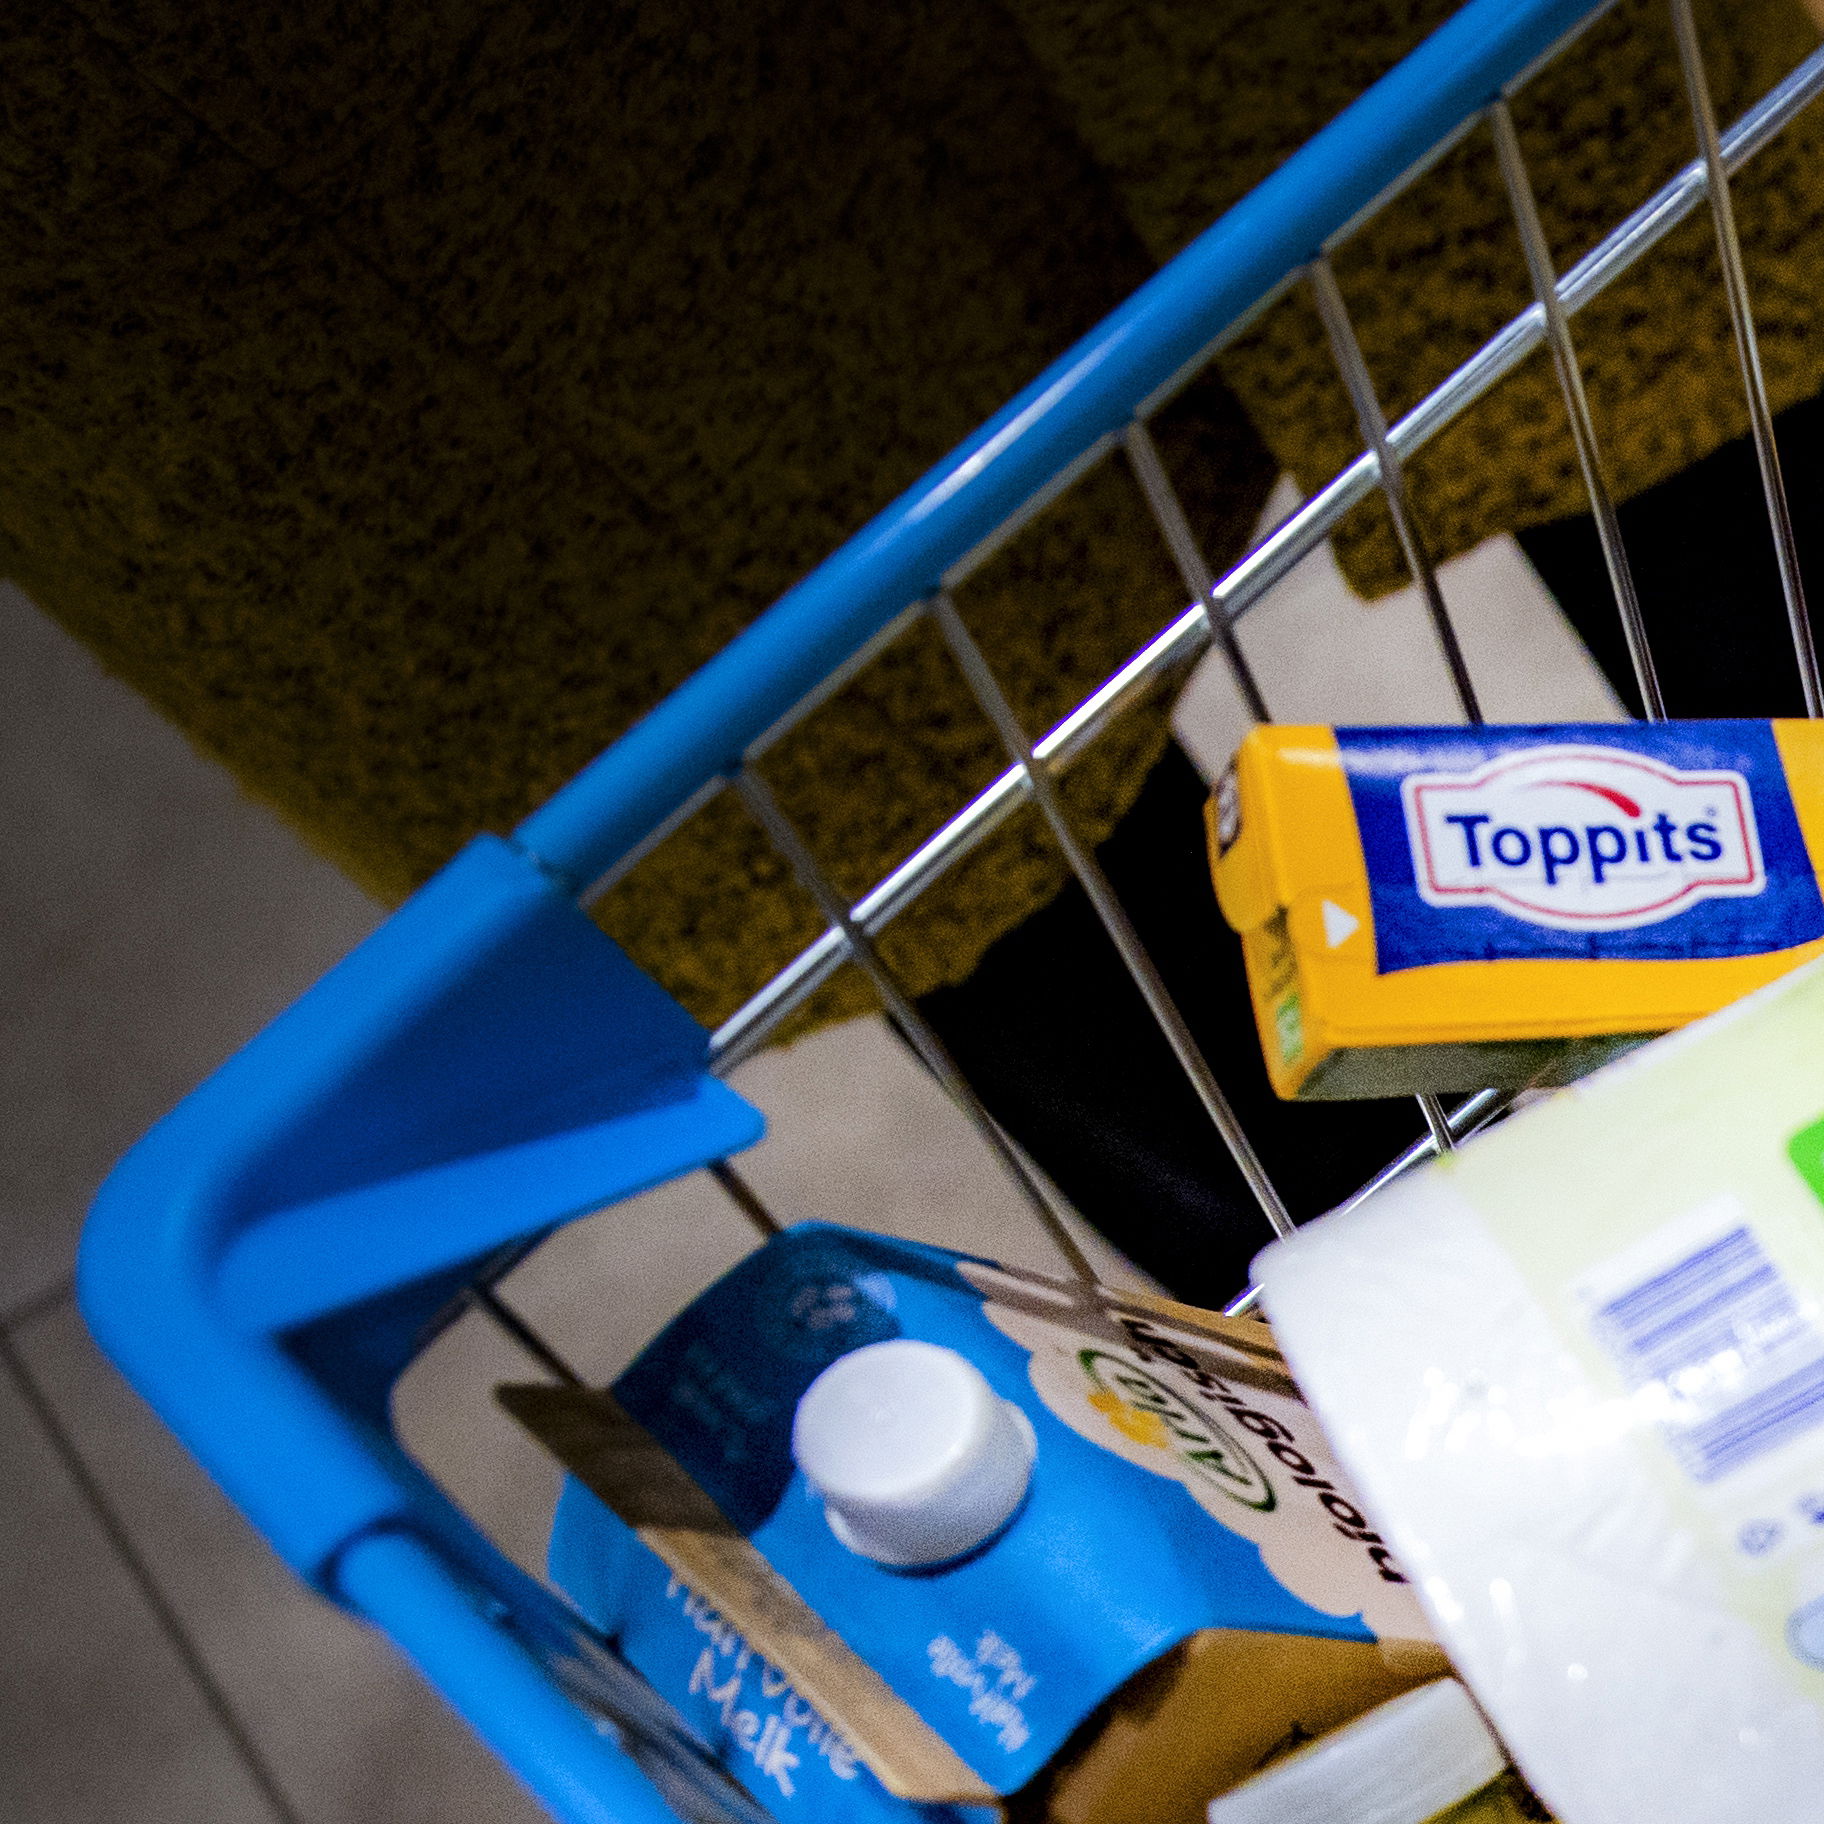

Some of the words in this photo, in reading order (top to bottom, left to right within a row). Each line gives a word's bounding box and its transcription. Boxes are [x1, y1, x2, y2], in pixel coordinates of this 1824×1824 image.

[1445, 804, 1724, 885] Toppits
[1118, 1372, 1255, 1488] Arla
[690, 1647, 799, 1800] Melk
